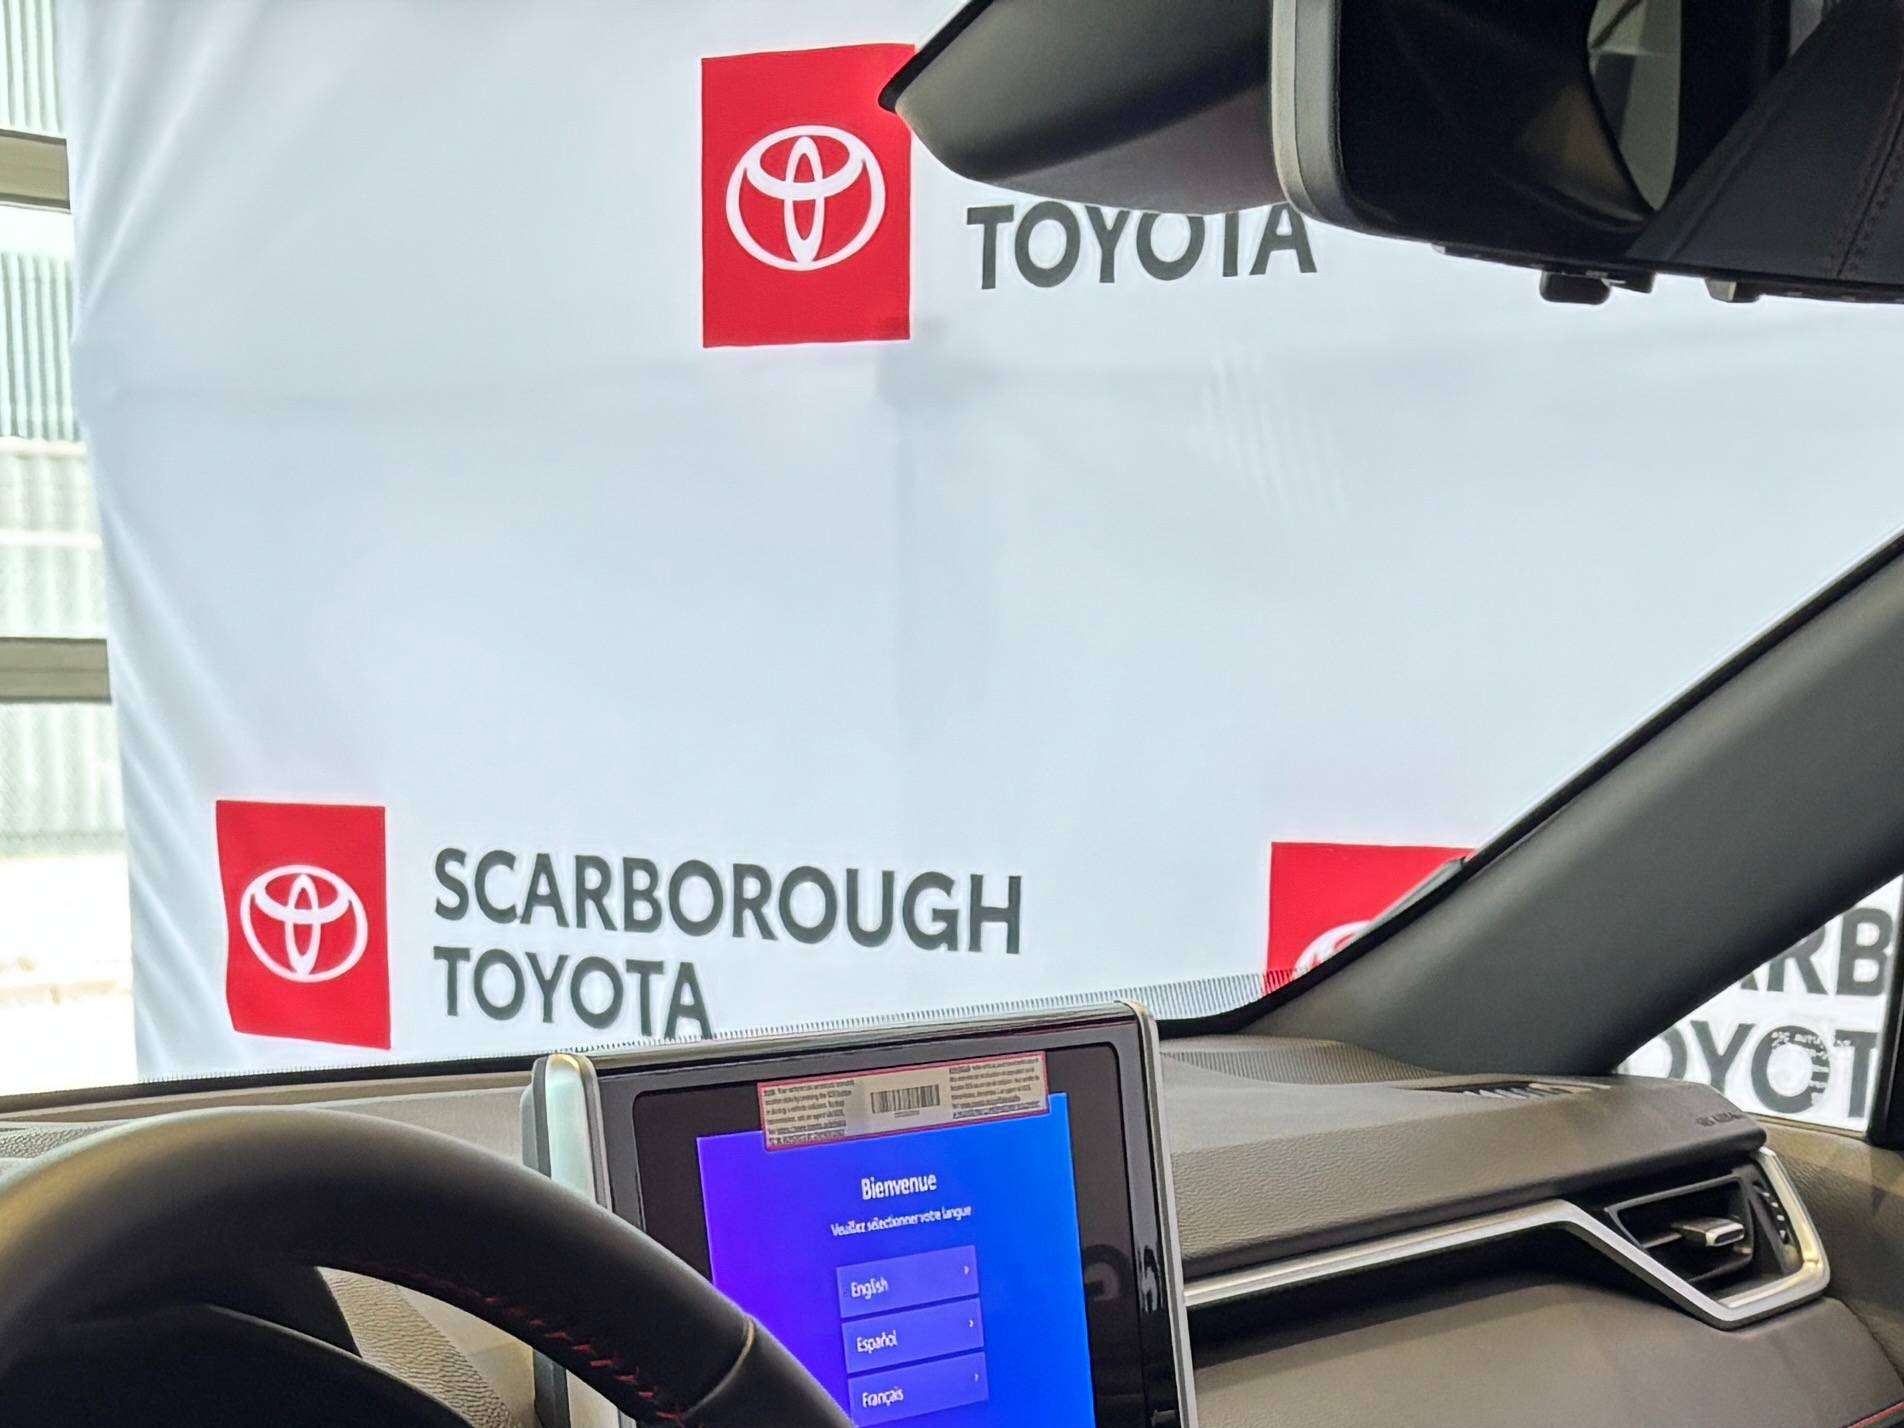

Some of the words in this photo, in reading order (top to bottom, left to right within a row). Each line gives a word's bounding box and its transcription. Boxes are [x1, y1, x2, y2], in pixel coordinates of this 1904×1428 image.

[435, 847, 1022, 955] SCARBOROUGH
[433, 945, 713, 1041] TOYOTA
[861, 1174, 937, 1200] Bienvenue
[851, 1277, 889, 1299] English
[856, 1330, 897, 1353] Español
[862, 1386, 903, 1408] Français
